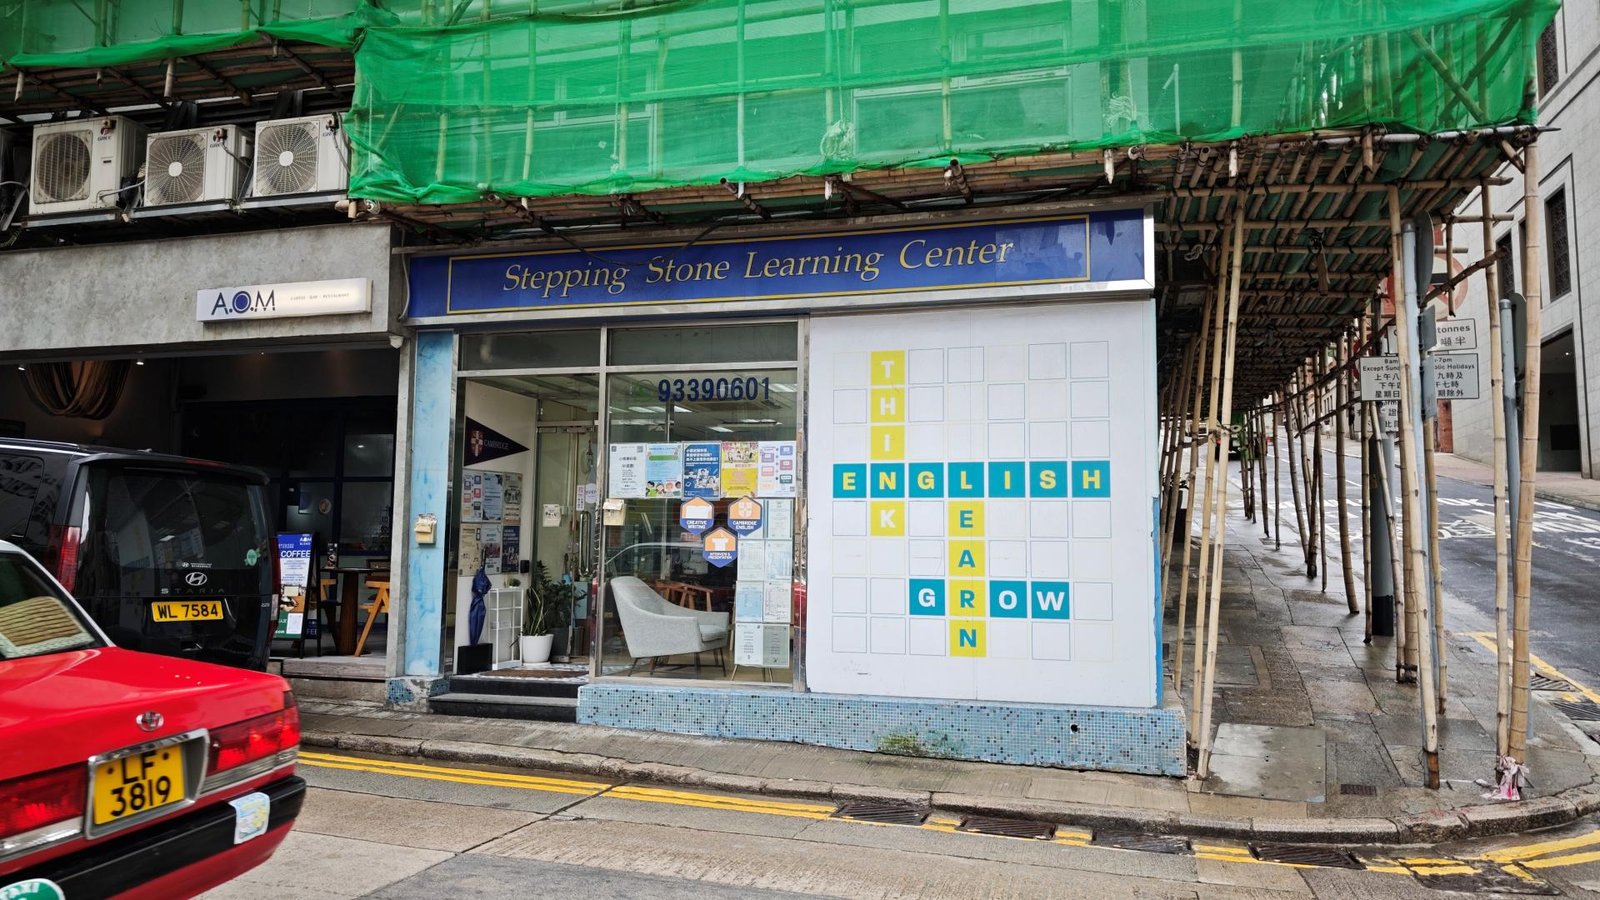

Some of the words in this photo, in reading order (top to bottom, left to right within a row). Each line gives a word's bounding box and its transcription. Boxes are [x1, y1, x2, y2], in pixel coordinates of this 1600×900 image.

[503, 260, 630, 298] Stepping
[645, 255, 730, 284] Stone
[744, 245, 884, 282] Learning
[899, 238, 1015, 269] Center
[211, 289, 276, 316] A.O.M
[1437, 325, 1471, 334] tonnes
[658, 376, 770, 403] 93390601
[879, 360, 896, 528] THINK
[842, 468, 1101, 491] ENGLISH
[281, 550, 311, 558] COFFEE
[958, 470, 977, 648] LEARN
[157, 604, 178, 620] WL
[180, 603, 218, 618] 7584
[918, 587, 1066, 612] GROW
[121, 750, 157, 785] LF
[111, 776, 171, 816] 3819
